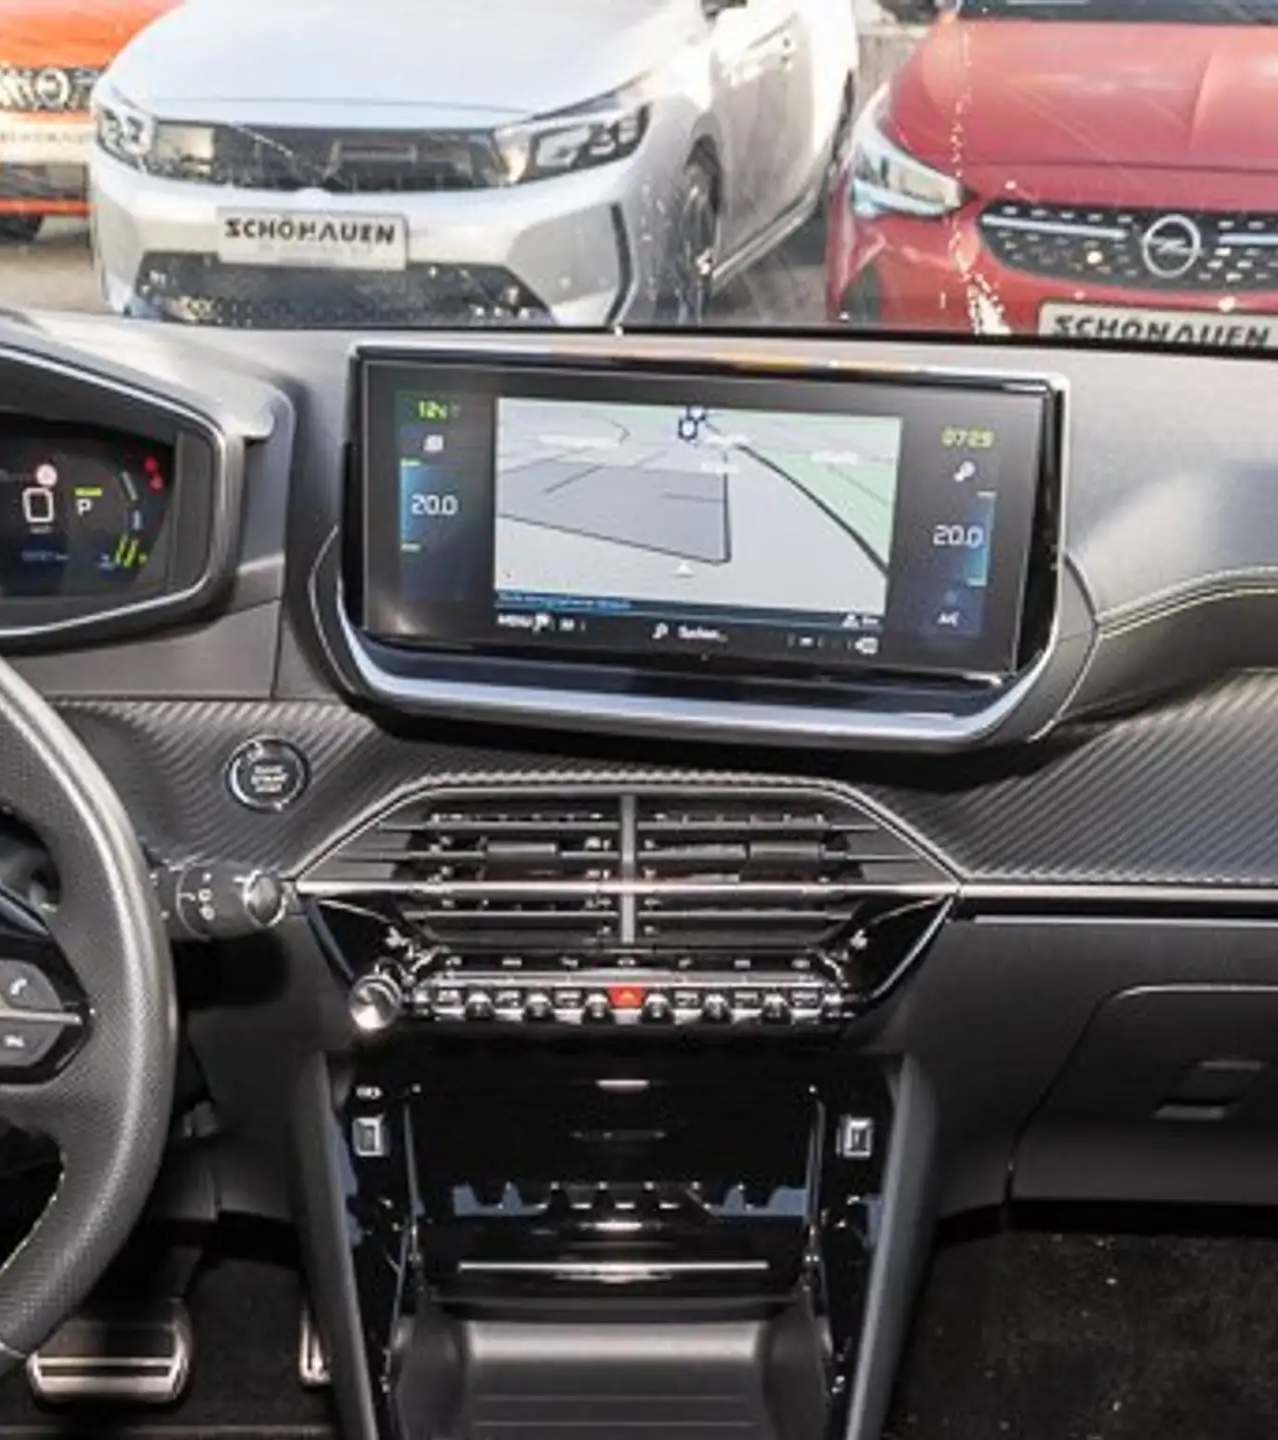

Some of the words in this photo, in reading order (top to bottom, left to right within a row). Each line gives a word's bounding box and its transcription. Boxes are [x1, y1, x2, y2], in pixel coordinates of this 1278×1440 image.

[76, 499, 92, 517] P
[411, 492, 459, 516] 20.0
[932, 523, 984, 549] 20.0
